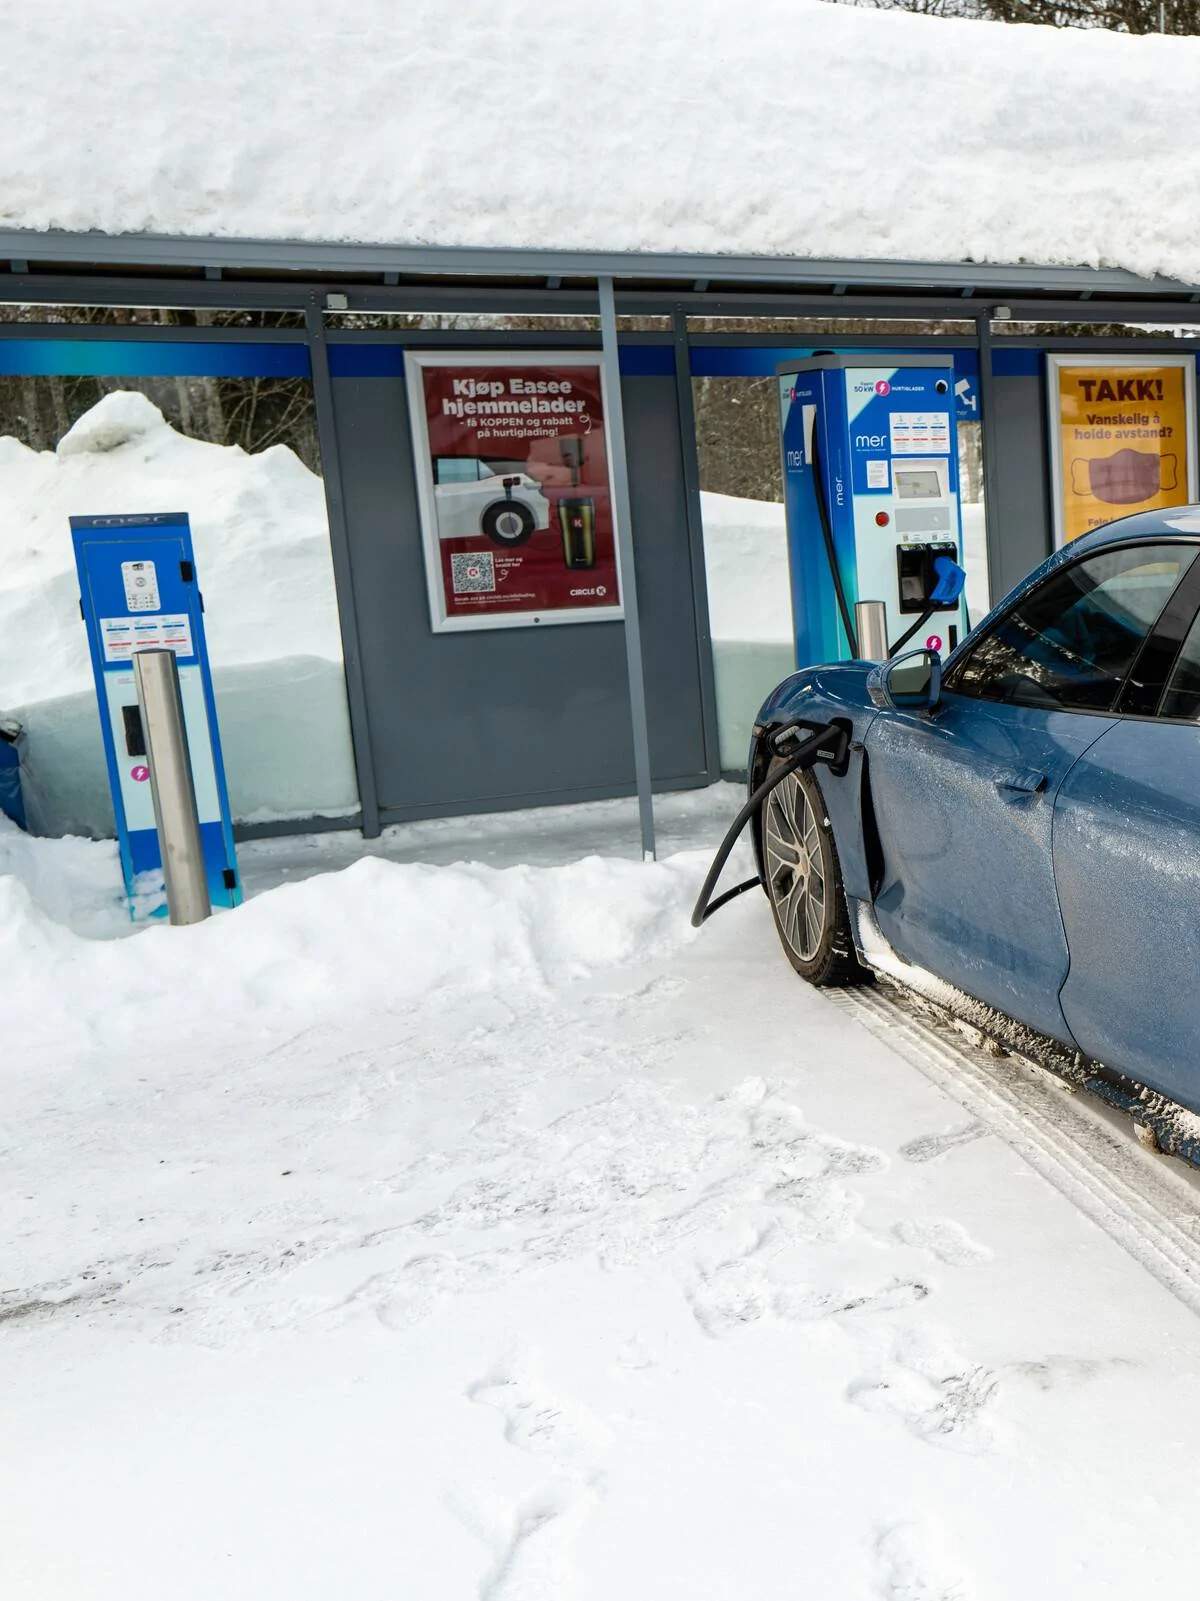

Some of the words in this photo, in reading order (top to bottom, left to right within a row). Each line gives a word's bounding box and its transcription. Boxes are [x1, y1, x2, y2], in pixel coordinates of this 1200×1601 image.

[452, 378, 505, 398] Kjøp
[509, 378, 572, 395] Easee
[1078, 379, 1164, 402] TAKK!
[442, 397, 586, 417] hjemmelader
[467, 417, 476, 427] få
[480, 417, 524, 427] KOPPEN
[528, 419, 540, 428] og
[543, 417, 573, 426] rabatt
[1086, 413, 1149, 425] Vanskelig
[1152, 411, 1160, 423] å
[477, 428, 490, 438] på
[493, 427, 558, 438] hurtiglading!
[1074, 428, 1112, 439] holde
[1115, 427, 1173, 438] avstand?
[856, 435, 887, 447] mer
[787, 450, 803, 466] mer
[836, 477, 844, 506] mer
[92, 515, 166, 526] mer
[570, 588, 595, 596] CIRCLE
